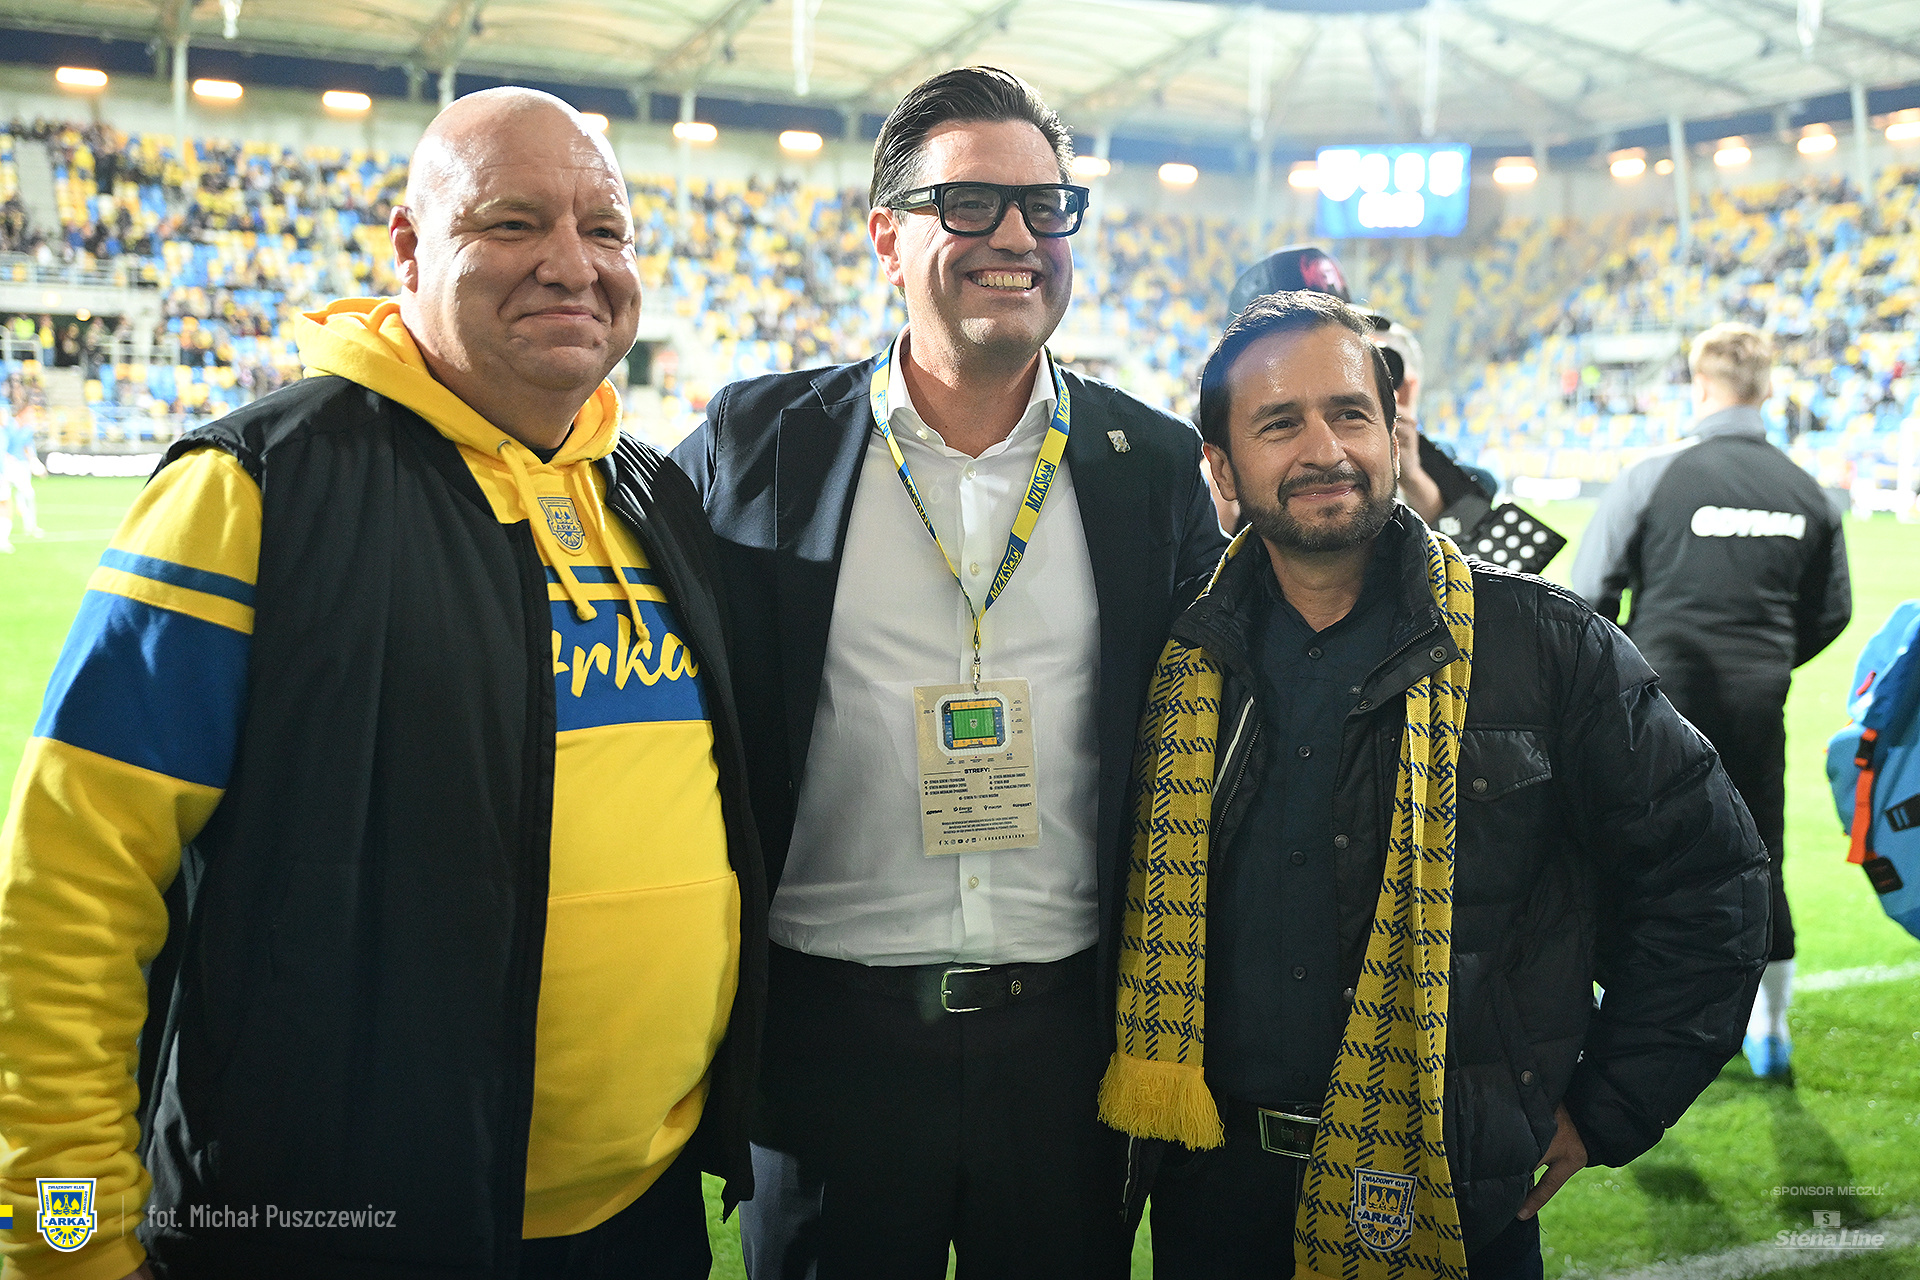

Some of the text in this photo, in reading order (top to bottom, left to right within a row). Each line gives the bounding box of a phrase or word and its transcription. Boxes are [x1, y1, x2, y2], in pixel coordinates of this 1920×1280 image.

[1024, 476, 1049, 513] MZKS
[990, 564, 1012, 600] MZKS
[1361, 1210, 1402, 1227] ARKA
